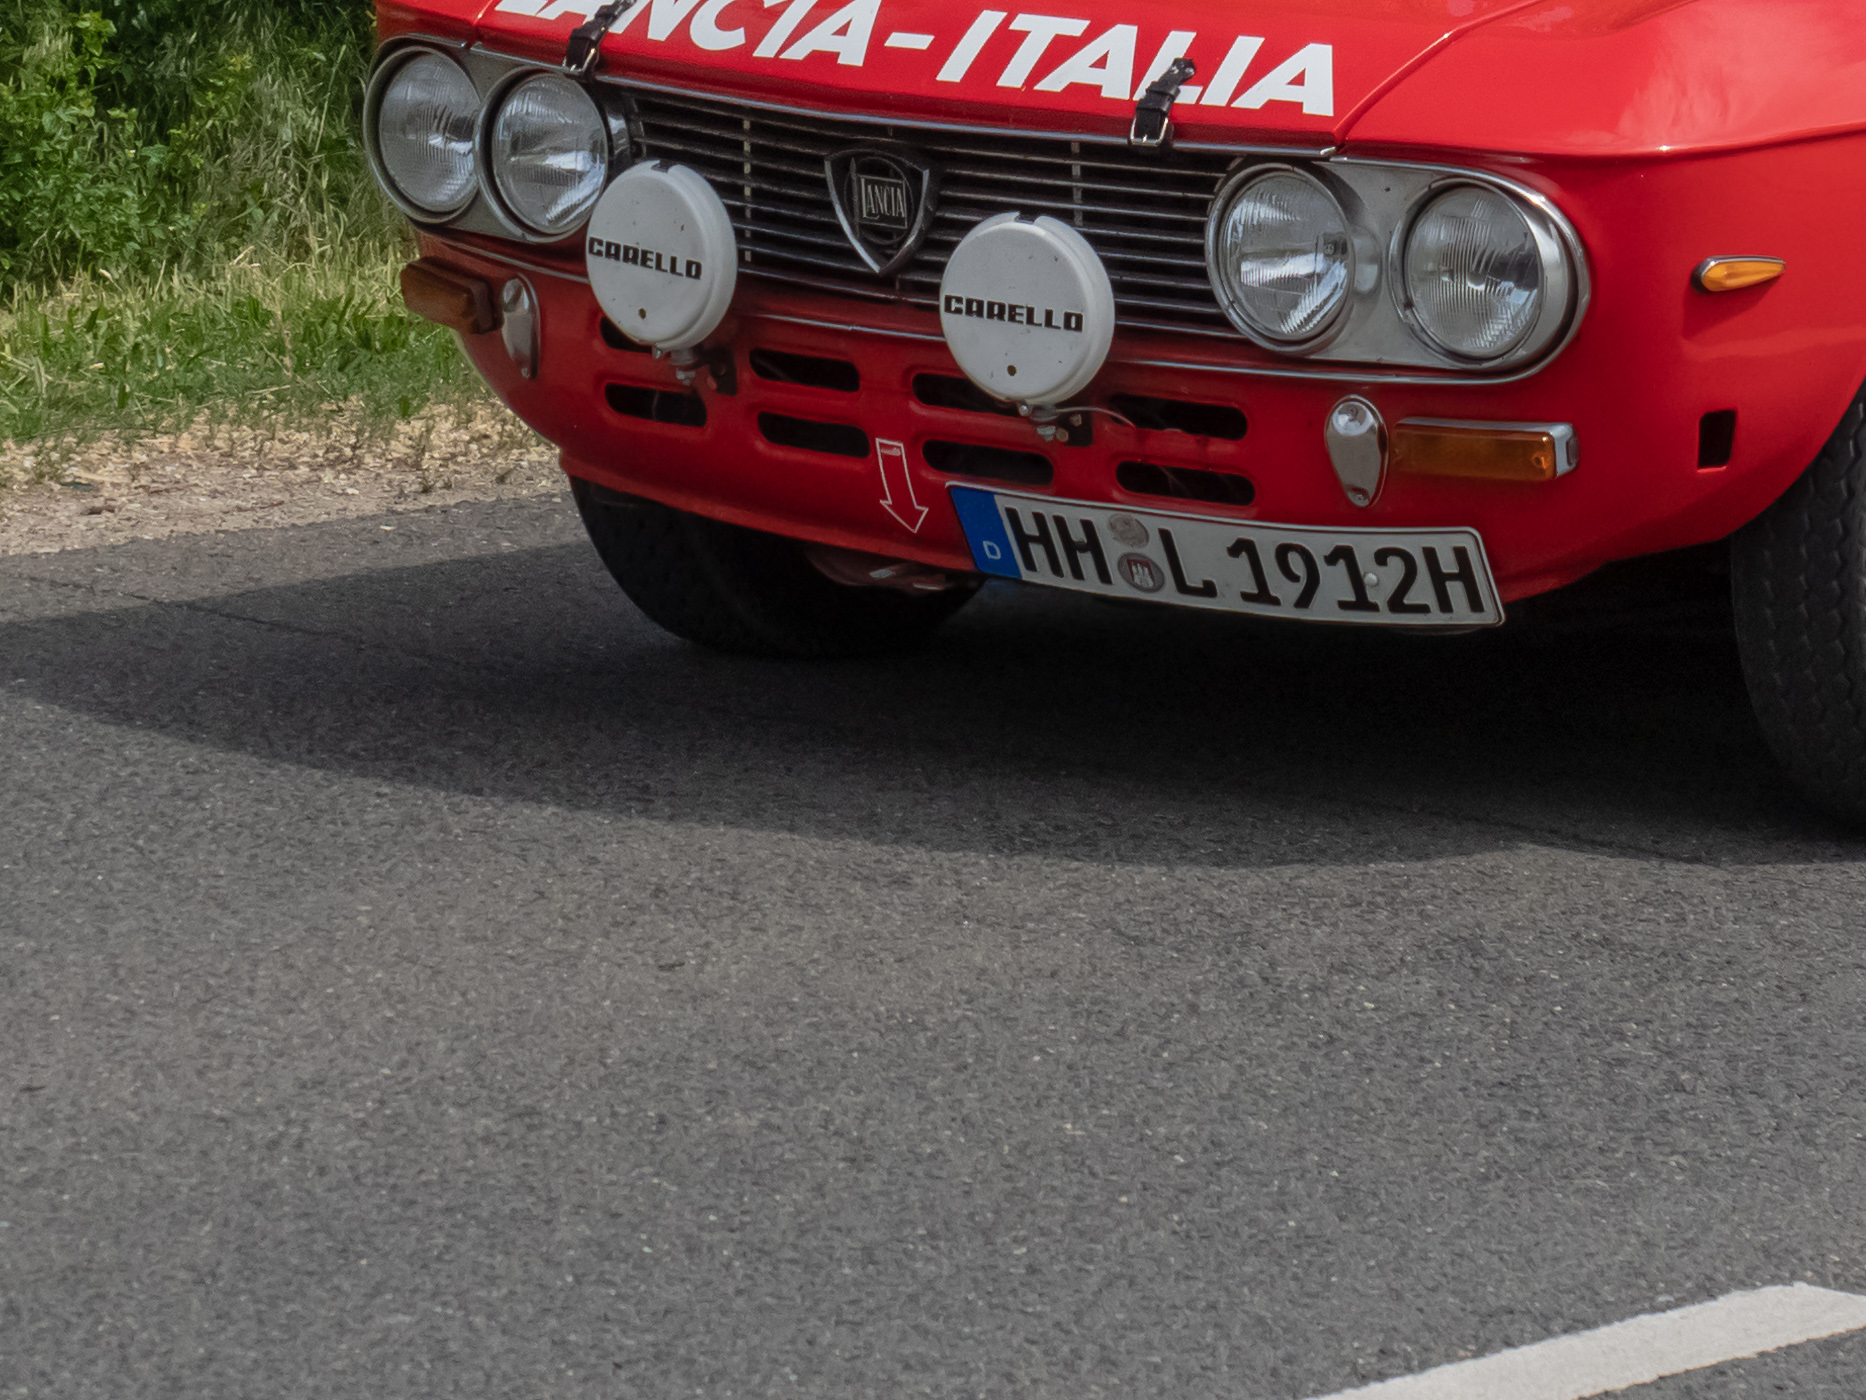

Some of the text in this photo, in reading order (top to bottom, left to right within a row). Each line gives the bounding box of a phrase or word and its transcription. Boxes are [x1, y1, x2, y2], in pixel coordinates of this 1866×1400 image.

[861, 178, 906, 219] LANCIA
[588, 236, 703, 281] CARELLO
[944, 293, 1084, 333] CARELLO
[982, 540, 1001, 560] D
[1005, 506, 1486, 614] HH L 1912H
